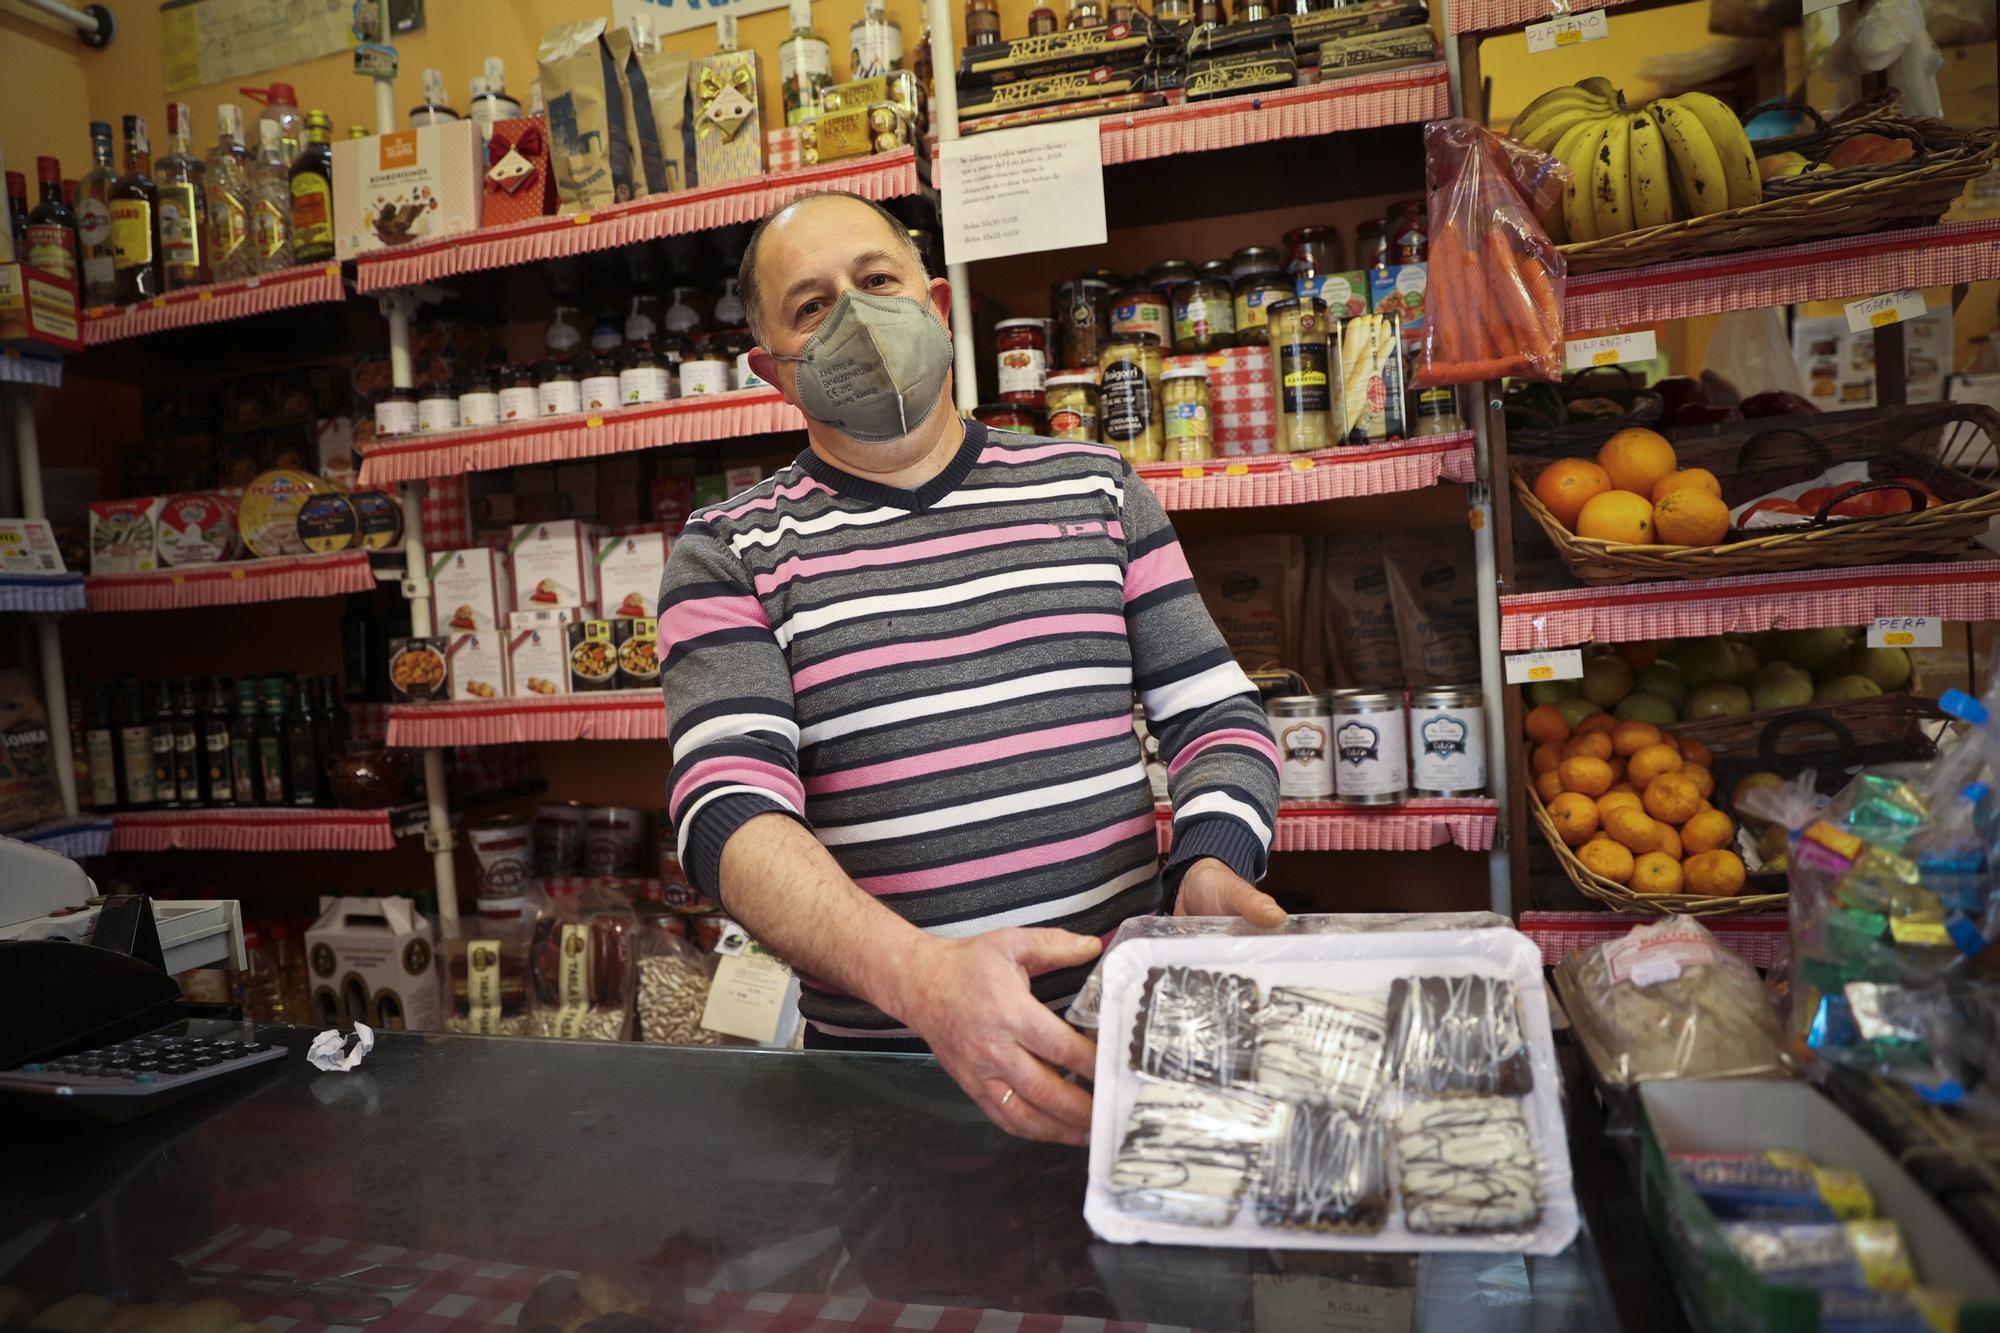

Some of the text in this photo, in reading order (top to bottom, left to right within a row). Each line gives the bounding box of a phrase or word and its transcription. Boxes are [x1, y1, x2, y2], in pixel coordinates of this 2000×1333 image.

[1528, 15, 1600, 41] PLATANO
[1007, 28, 1106, 61] ARTESANO
[991, 74, 1089, 105] ARTESANO
[1854, 288, 1913, 314] TOMATE
[1878, 617, 1926, 630] PERA
[1328, 1299, 1371, 1316] RIOJA
